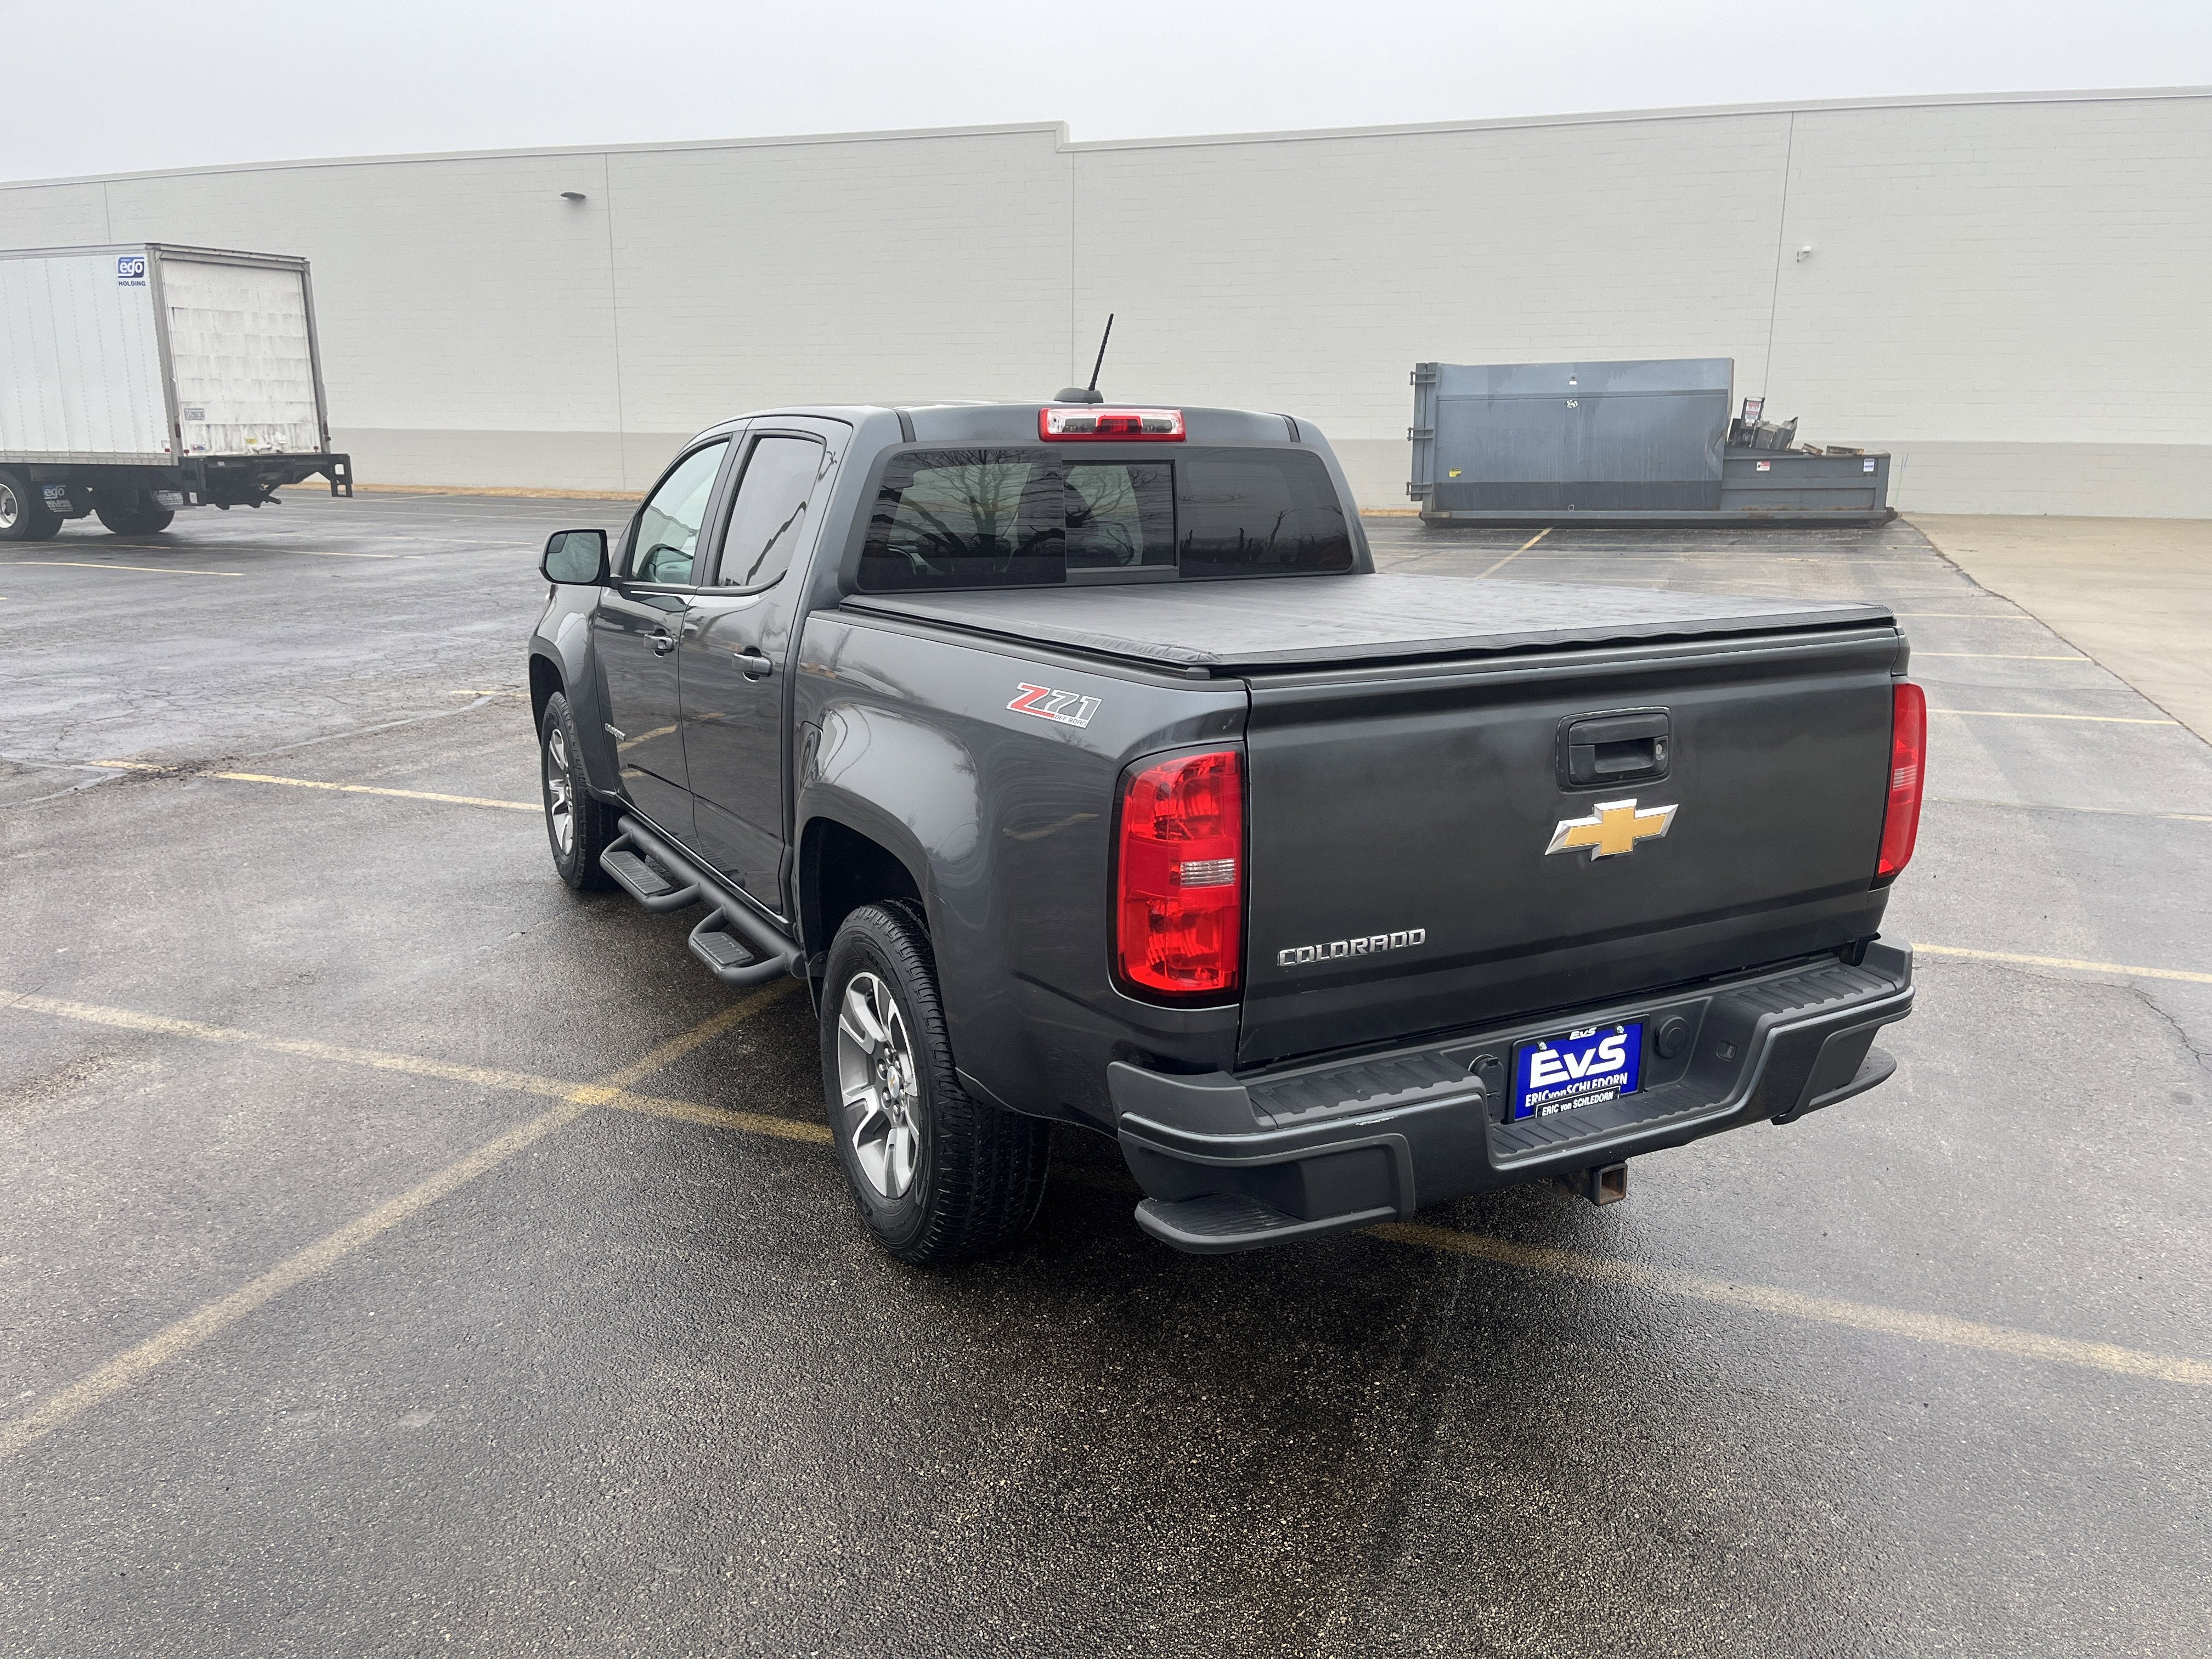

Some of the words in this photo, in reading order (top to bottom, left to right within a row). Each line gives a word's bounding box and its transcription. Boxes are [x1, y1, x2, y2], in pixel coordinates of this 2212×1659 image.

[119, 261, 143, 275] ego
[44, 487, 65, 499] ego
[1006, 681, 1103, 723] Z71
[1054, 714, 1068, 723] OFF
[1068, 718, 1087, 727] ROAD
[1277, 928, 1426, 967] COLORADO
[1542, 1103, 1559, 1116] ERIC
[1560, 1102, 1572, 1112] von
[1572, 1091, 1614, 1109] SCHLEDORN
